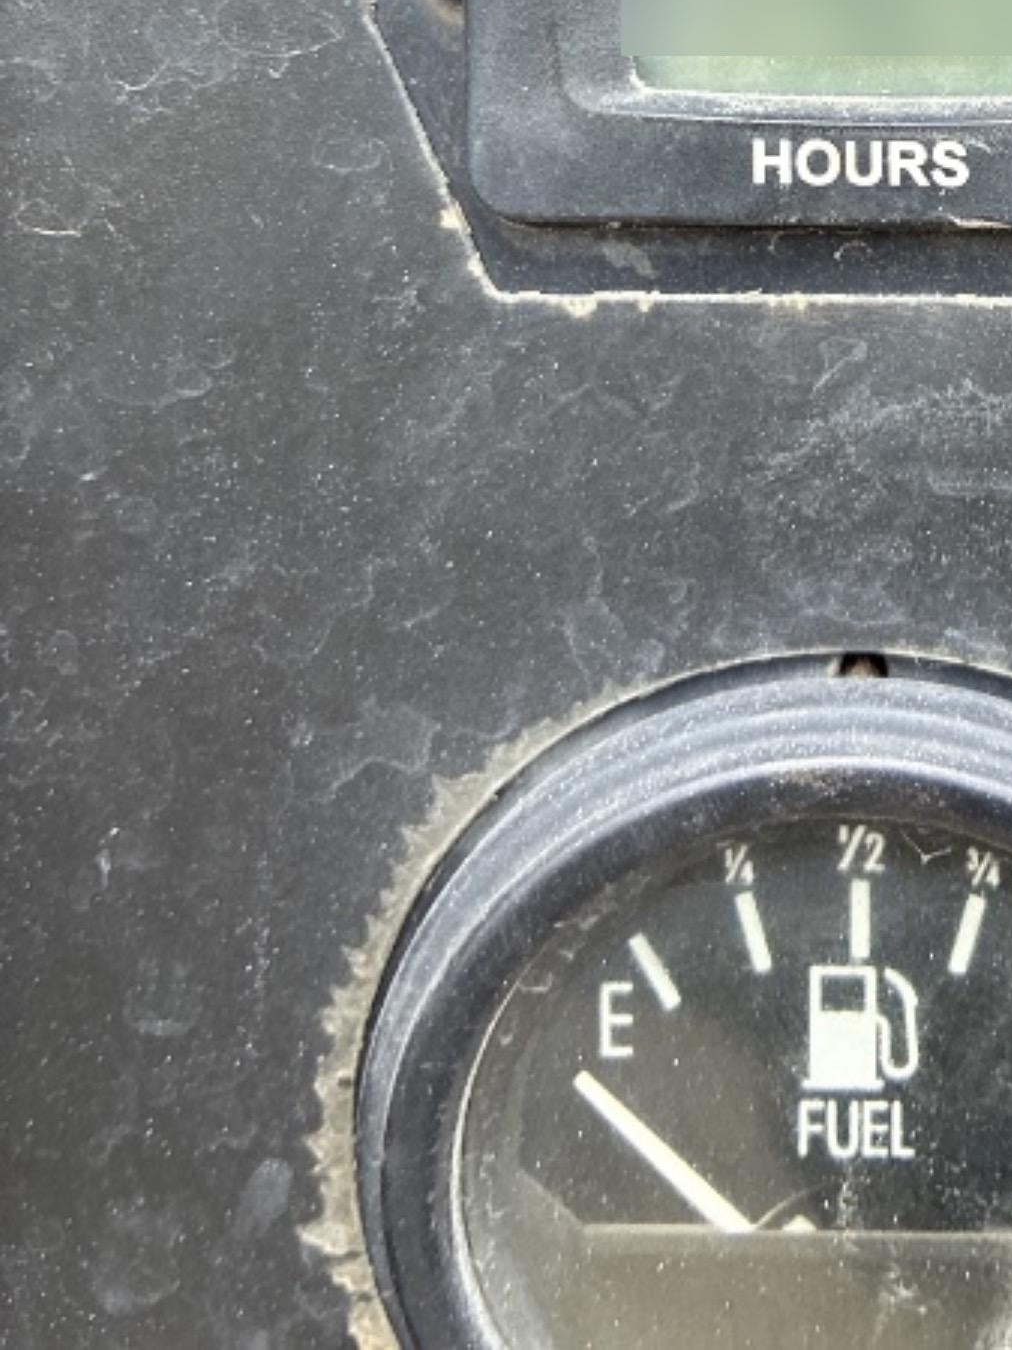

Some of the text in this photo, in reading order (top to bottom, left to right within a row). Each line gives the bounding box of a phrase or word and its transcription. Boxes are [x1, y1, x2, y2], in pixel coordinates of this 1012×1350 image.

[752, 138, 970, 190] HOURS
[837, 824, 886, 872] 1/2
[600, 982, 634, 1057] E
[798, 1100, 916, 1158] FUEL
